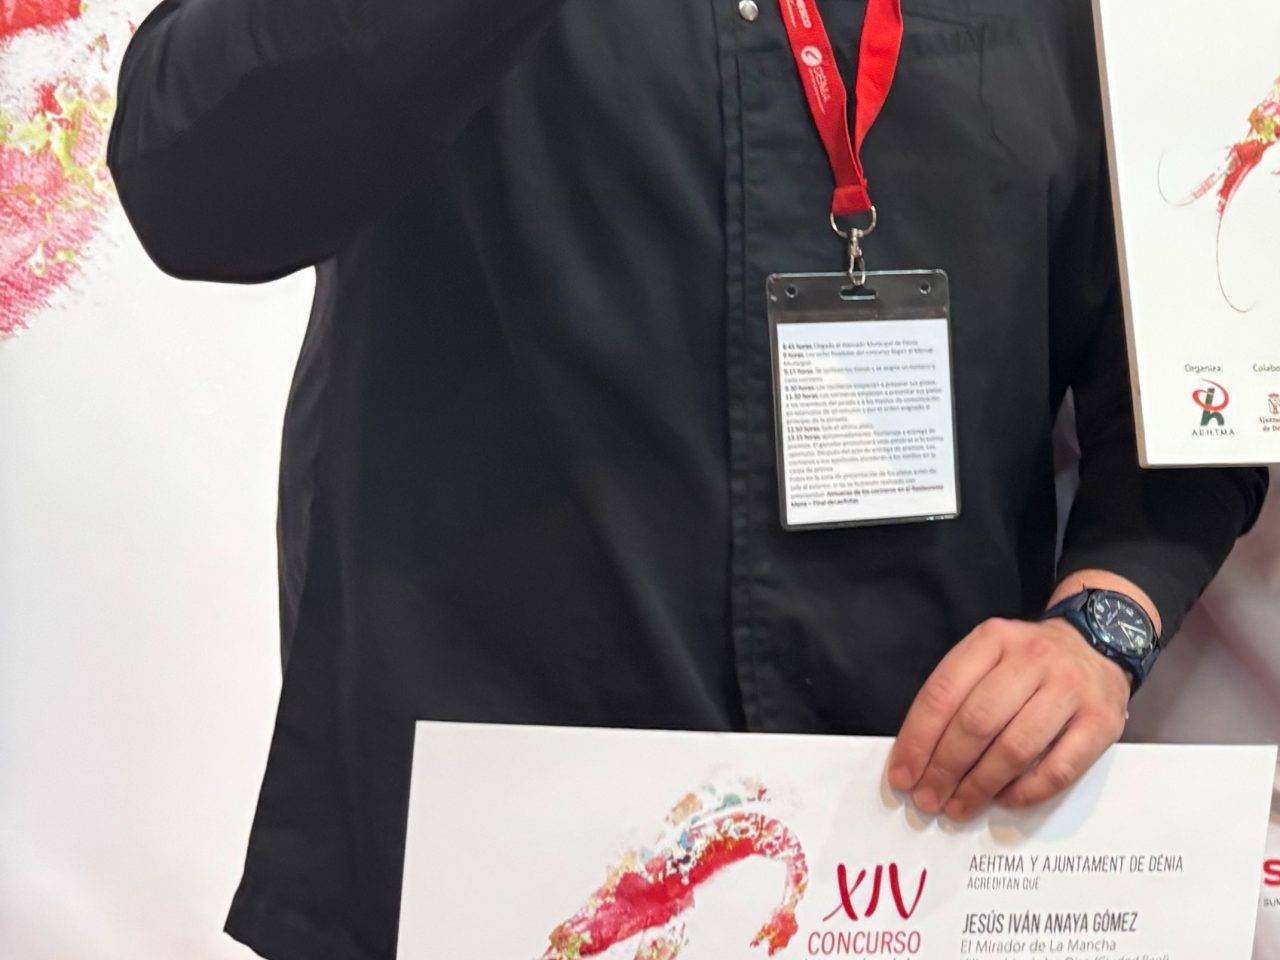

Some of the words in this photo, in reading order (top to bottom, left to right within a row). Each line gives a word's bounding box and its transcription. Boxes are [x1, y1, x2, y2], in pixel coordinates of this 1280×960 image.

[969, 854, 1024, 873] AEHTMA
[1030, 855, 1038, 872] Y
[1042, 855, 1126, 873] AJUNTAMENT
[1129, 855, 1145, 872] DE
[1148, 852, 1183, 872] DÉNIA
[822, 862, 927, 922] XIV
[967, 876, 1020, 890] ACREDITAN
[963, 910, 1005, 934] JESÚS
[1008, 909, 1041, 934] IVÁN
[1044, 912, 1088, 933] ANAYA
[1093, 909, 1138, 933] GÓMEZ
[808, 930, 921, 956] CONCURSO
[960, 939, 971, 953] El
[975, 939, 1026, 953] Mirador
[1029, 939, 1045, 952] de
[1049, 939, 1063, 952] La
[1067, 938, 1117, 952] Mancha
